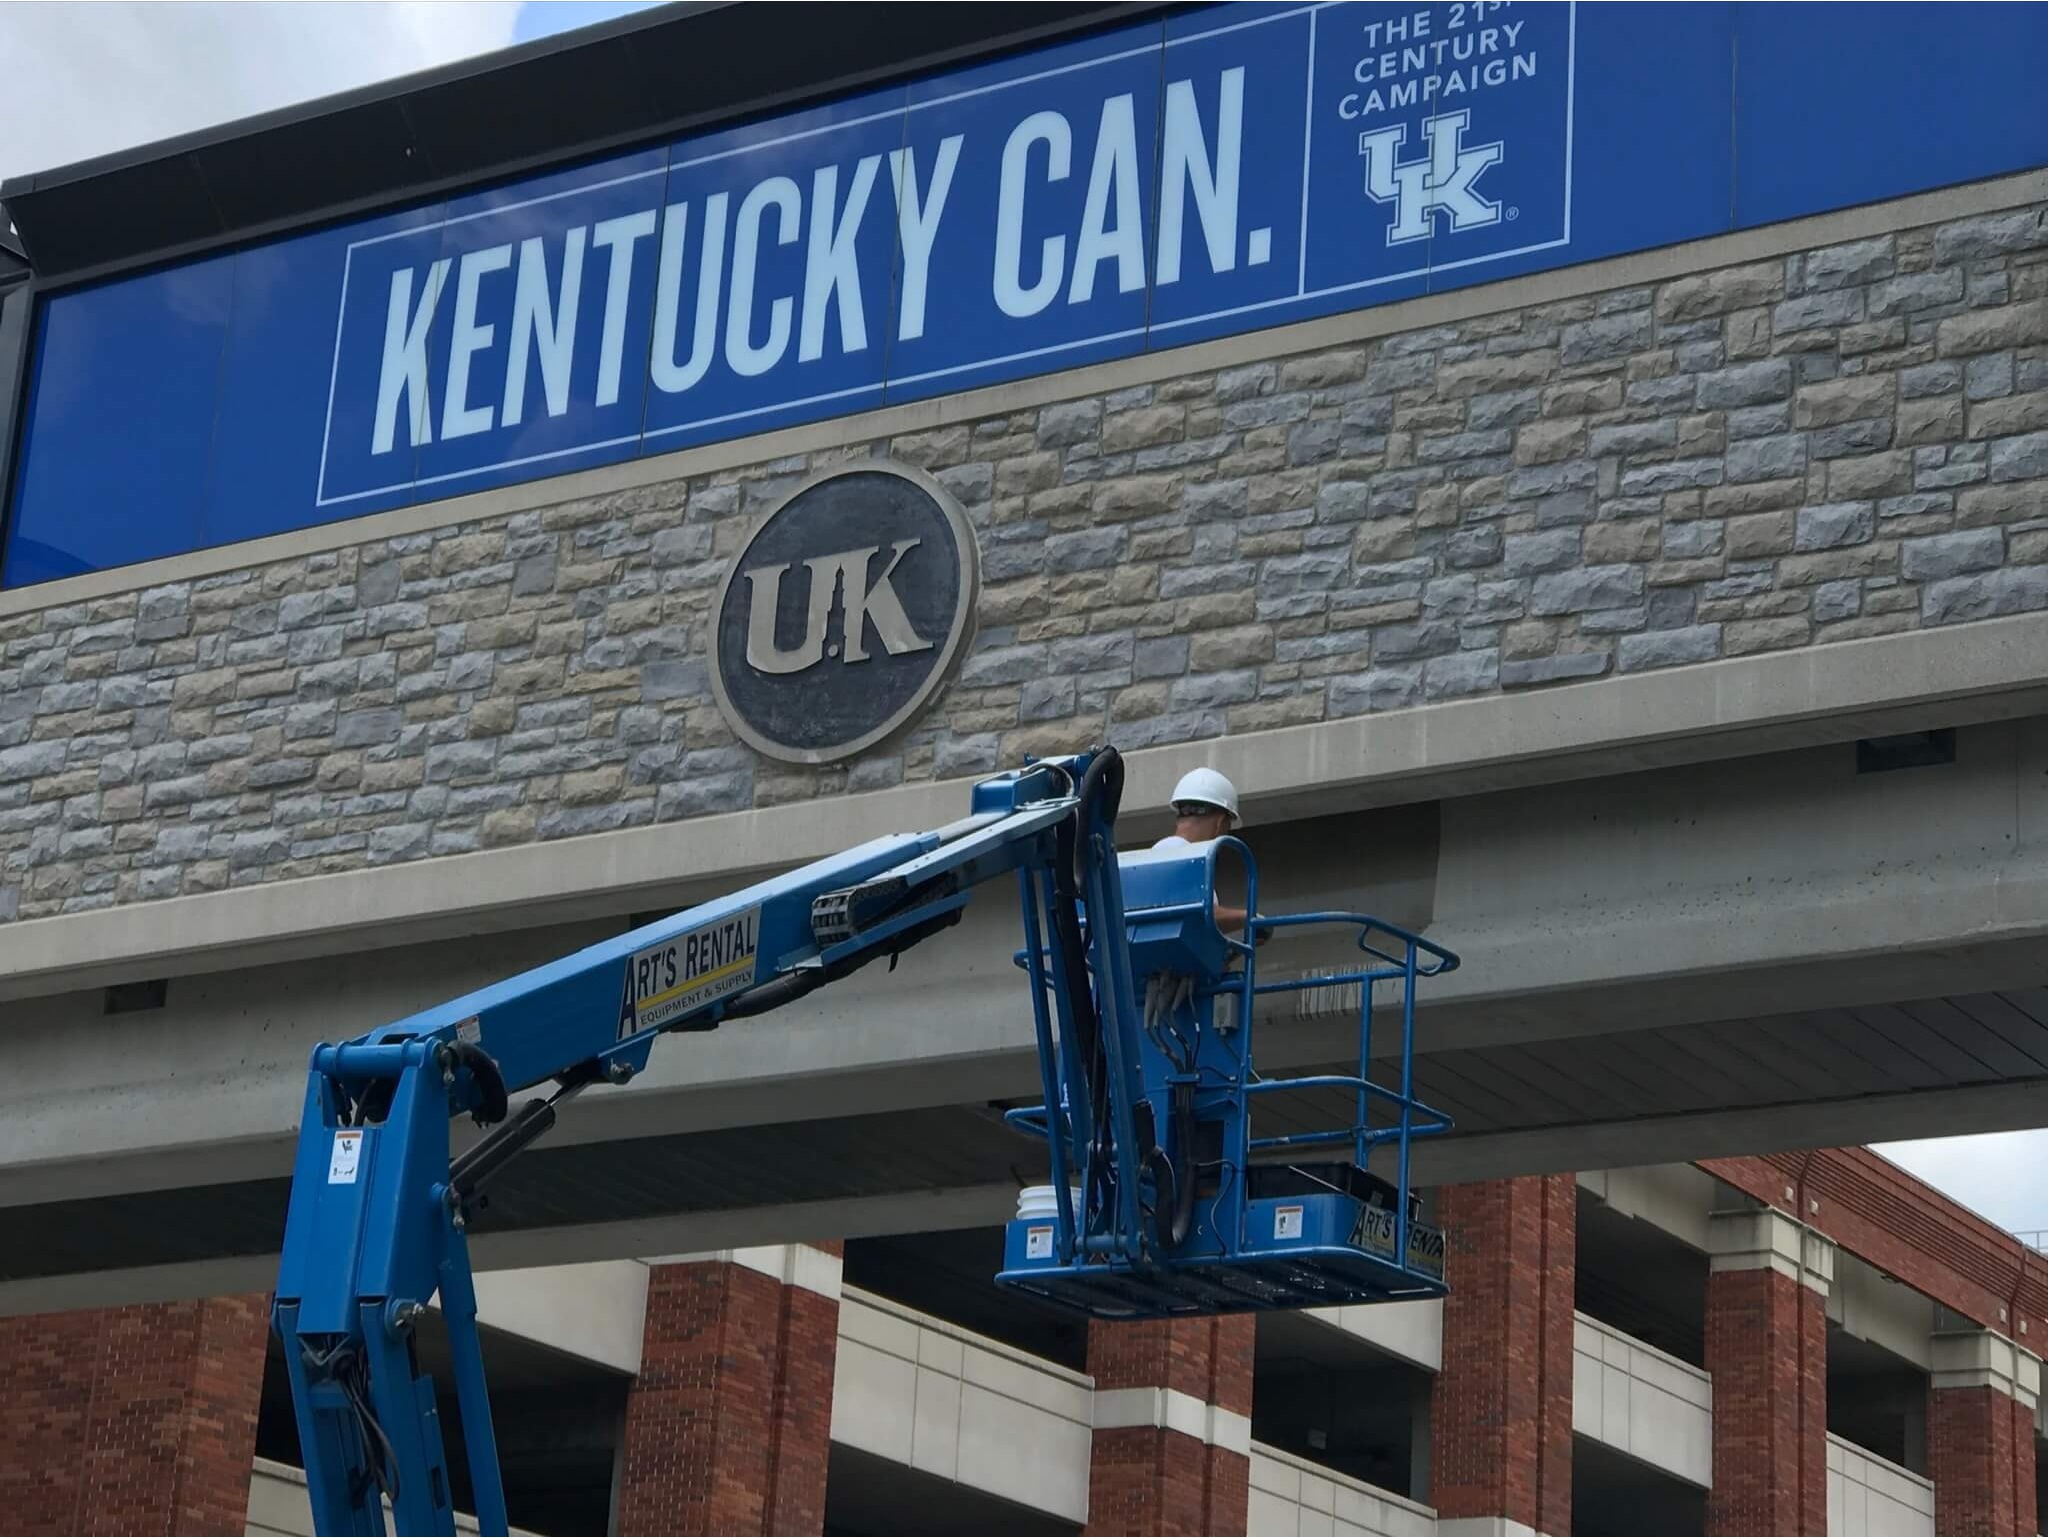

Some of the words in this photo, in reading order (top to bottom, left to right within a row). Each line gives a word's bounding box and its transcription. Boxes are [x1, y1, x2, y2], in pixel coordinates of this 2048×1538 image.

[1354, 20, 1525, 83] CENTURY
[1363, 10, 1431, 48] THE
[1338, 52, 1537, 120] CAMPAIGN
[1359, 108, 1504, 247] UK
[371, 133, 965, 456] KENTUCKY
[992, 66, 1273, 319] CAN.
[617, 945, 677, 1040] ART'S
[685, 915, 755, 981] RENTAL
[640, 991, 701, 1026] EQUIPMENT
[704, 986, 713, 998] &
[715, 970, 753, 994] SUPPLY
